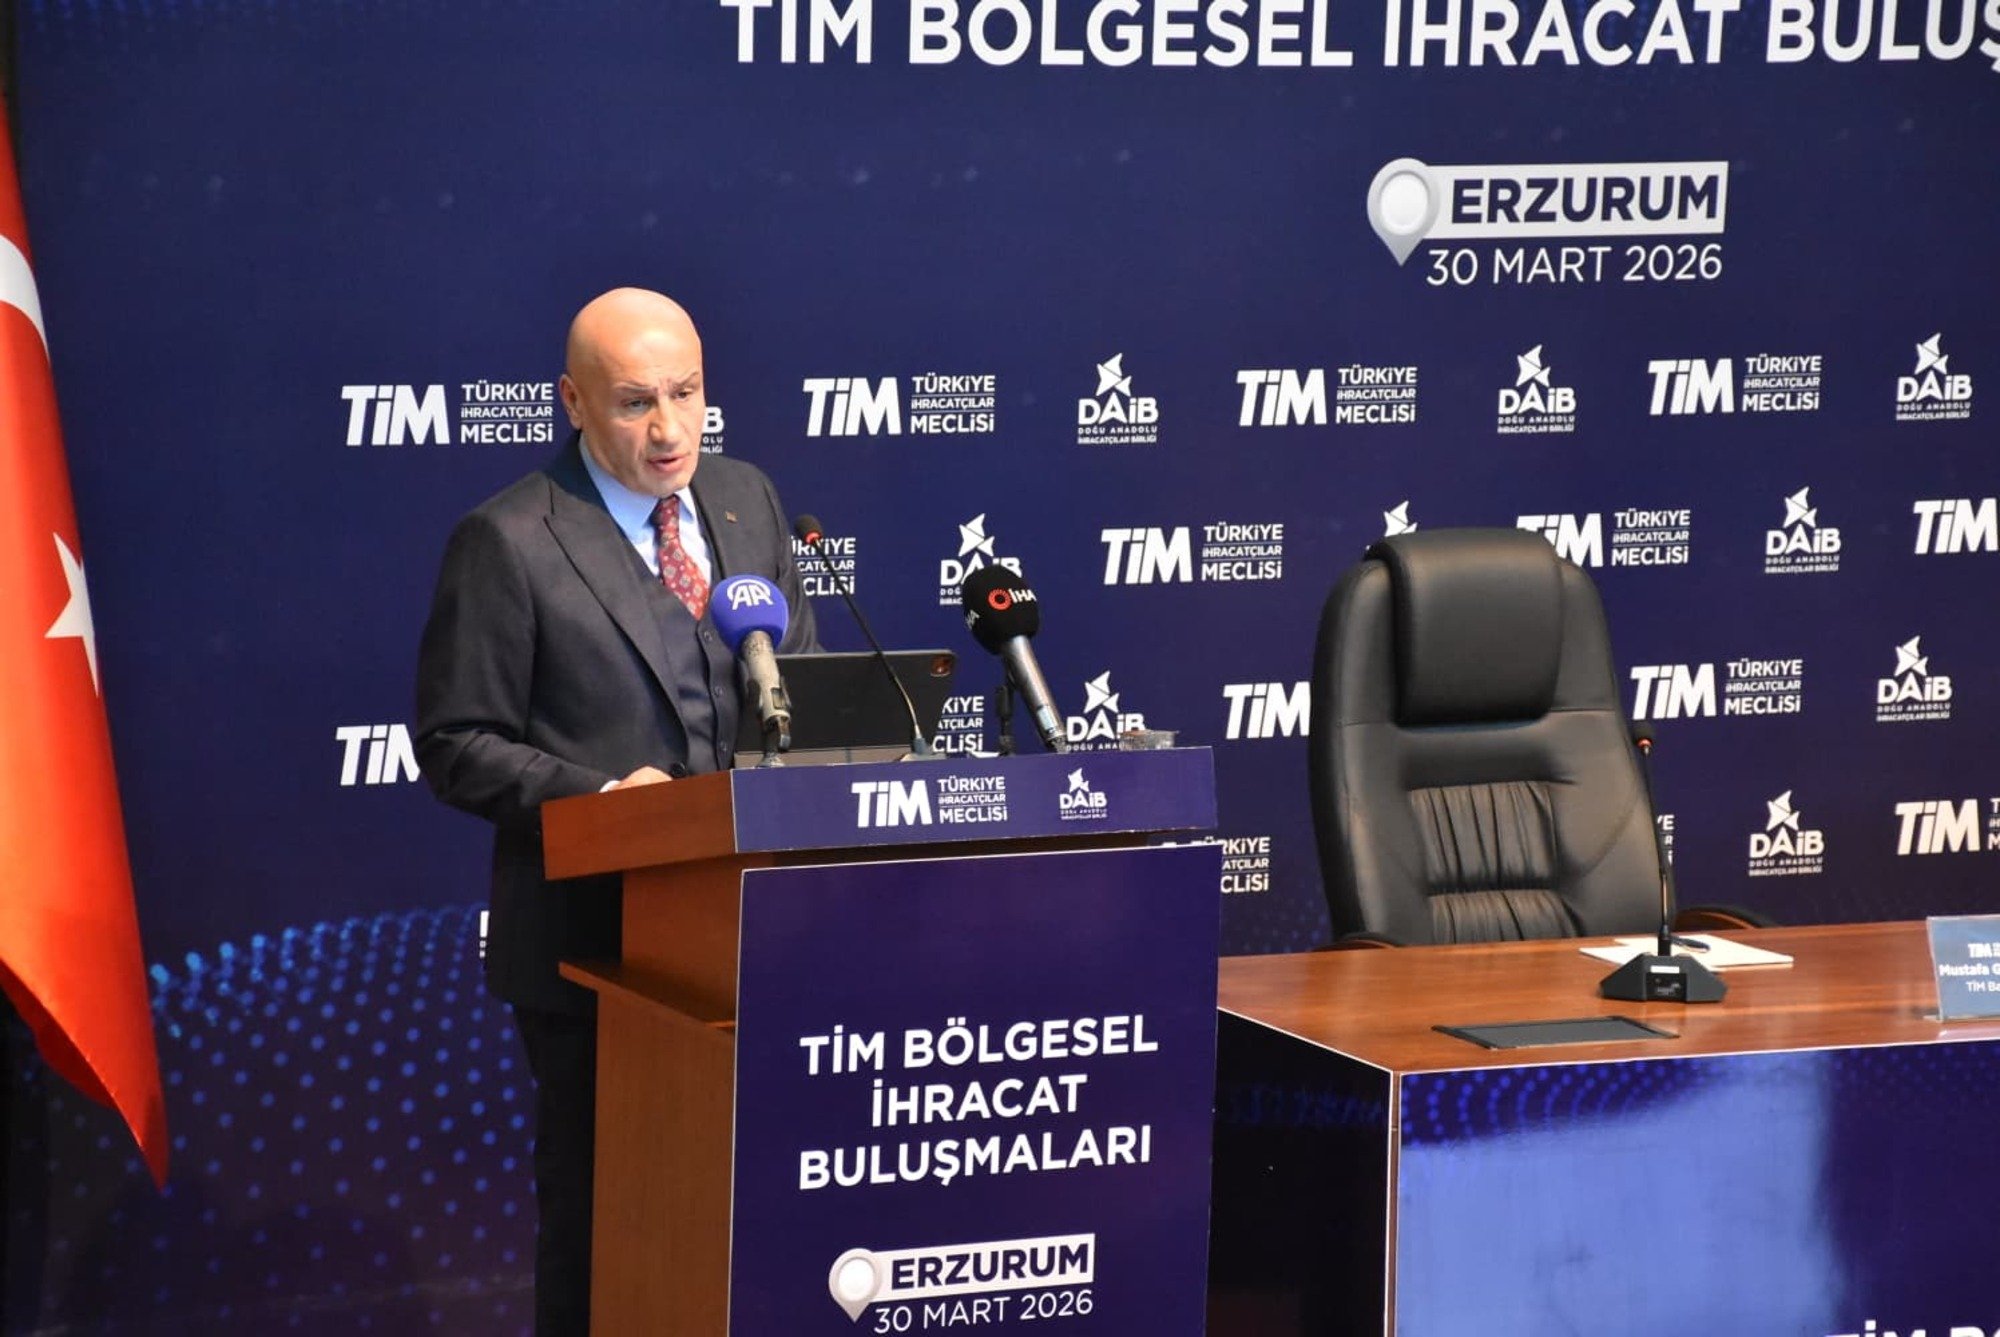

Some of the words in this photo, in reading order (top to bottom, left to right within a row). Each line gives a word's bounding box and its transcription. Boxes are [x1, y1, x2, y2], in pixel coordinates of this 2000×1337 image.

[1452, 175, 1719, 224] ERZURUM
[1426, 249, 1478, 286] 30
[1493, 247, 1612, 284] MART
[1623, 244, 1722, 281] 2026
[728, 579, 773, 610] AA
[1939, 963, 1990, 976] Mustafa
[800, 1024, 885, 1075] TİM
[904, 1014, 1158, 1069] BÖLGESEL
[871, 1074, 1087, 1127] İHRACAT
[799, 1125, 1151, 1189] BULUŞMALARI
[891, 1243, 1088, 1290] ERZURUM
[874, 1306, 912, 1334] 30
[923, 1297, 1011, 1329] MART
[1020, 1289, 1093, 1320] 2026
